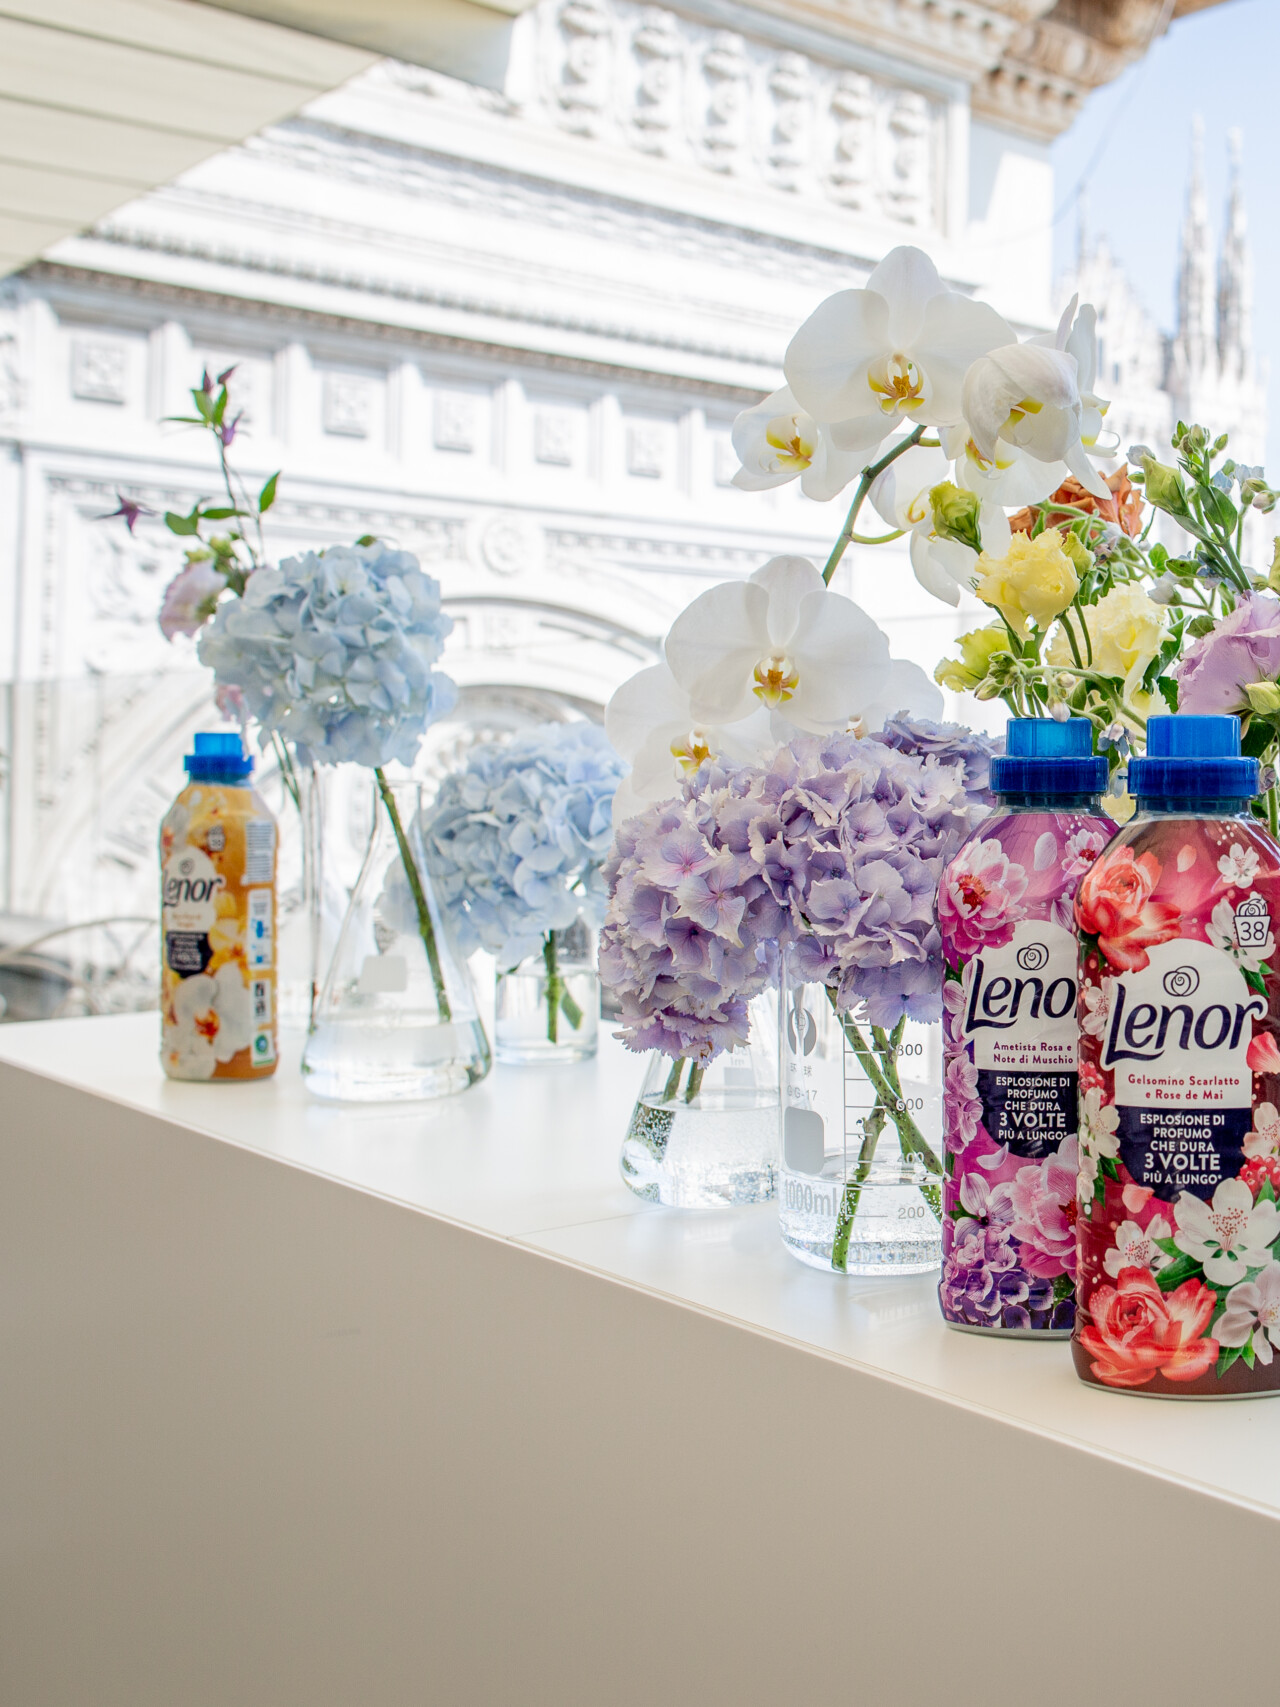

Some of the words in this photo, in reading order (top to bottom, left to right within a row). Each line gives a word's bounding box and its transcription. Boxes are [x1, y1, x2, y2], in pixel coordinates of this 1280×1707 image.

[1240, 921, 1265, 941] 38
[965, 958, 1077, 1034] Leno
[1105, 983, 1263, 1066] Lenor
[896, 1044, 923, 1056] 800
[993, 1041, 1036, 1051] Ametista
[1040, 1042, 1063, 1051] Rosa
[993, 1053, 1016, 1063] Note
[1019, 1054, 1029, 1064] di
[1032, 1055, 1074, 1064] Muschio
[996, 1076, 1057, 1087] ESPLOSIONE
[1059, 1077, 1070, 1087] DI
[1128, 1074, 1185, 1086] Gelsomino
[1189, 1075, 1240, 1086] Scarlatto
[1007, 1089, 1058, 1099] PROFUMO
[1155, 1089, 1181, 1100] Rose
[1185, 1090, 1198, 1100] de
[1203, 1090, 1223, 1100] Mai
[896, 1098, 923, 1112] 600
[1004, 1101, 1027, 1111] CHE
[1029, 1102, 1061, 1111] DURA
[999, 1112, 1008, 1126] 3
[1011, 1112, 1066, 1128] VOLTE
[1140, 1113, 1211, 1126] ESPLOSIONE
[1213, 1115, 1225, 1126] DI
[998, 1127, 1016, 1140] PIÙ
[1017, 1131, 1025, 1140] A
[1153, 1127, 1212, 1139] PROFUMO
[1150, 1140, 1176, 1152] CHE
[1179, 1141, 1215, 1152] DURA
[1144, 1153, 1154, 1169] 3
[1158, 1153, 1220, 1171] VOLTE
[1143, 1170, 1162, 1183] PIÙ
[1164, 1174, 1173, 1184] A
[898, 1206, 925, 1219] 200
